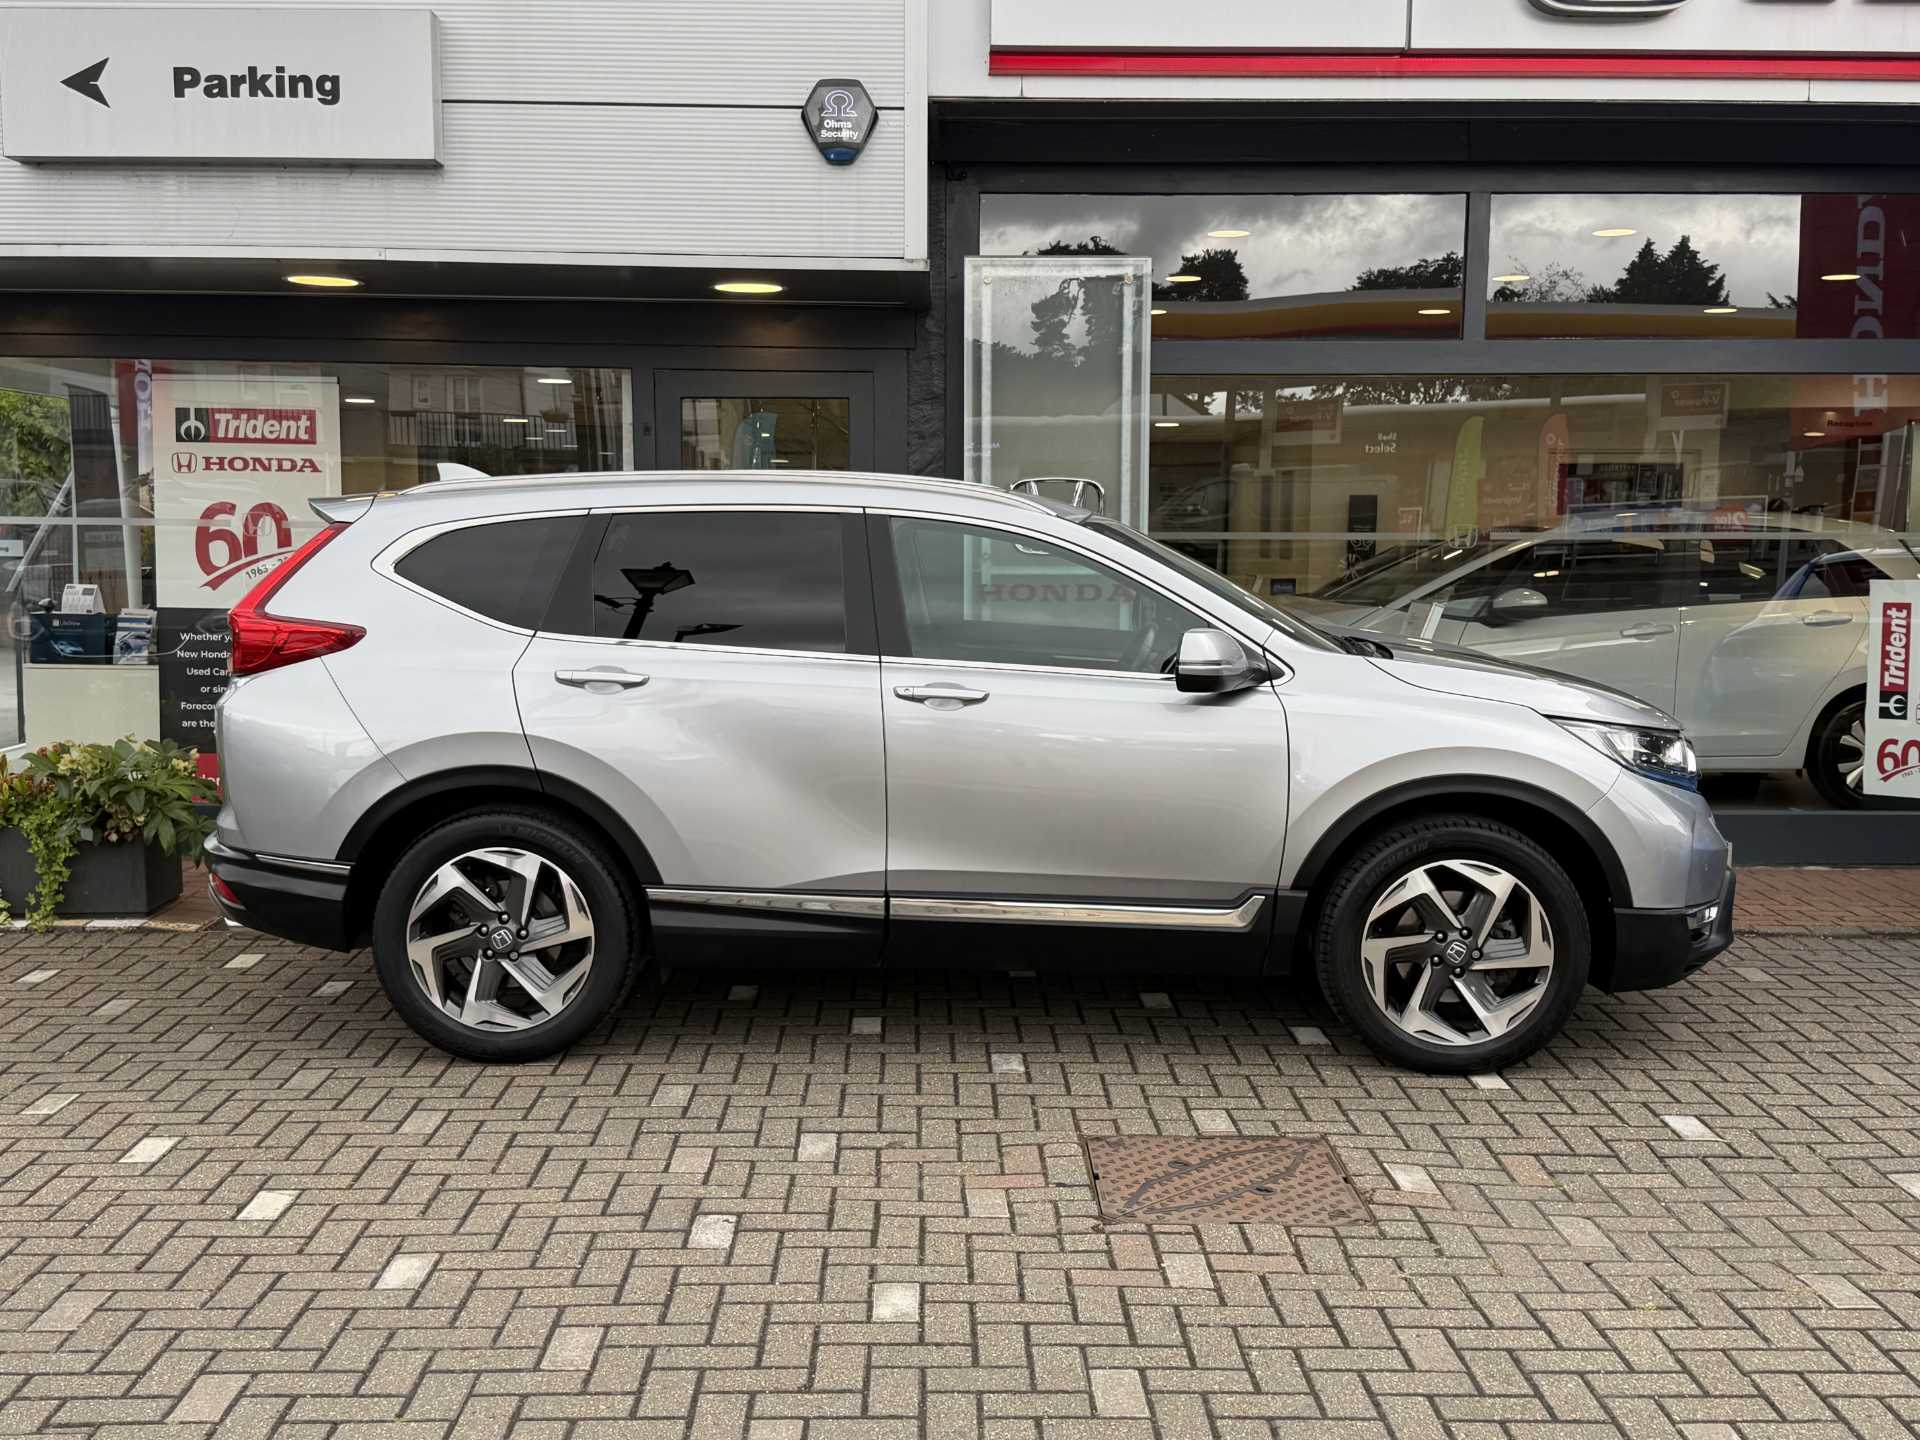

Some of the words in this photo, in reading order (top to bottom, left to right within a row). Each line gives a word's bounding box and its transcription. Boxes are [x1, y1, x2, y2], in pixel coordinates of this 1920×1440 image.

[173, 65, 341, 105] Parking
[824, 119, 853, 129] Ohms
[820, 129, 859, 140] Security
[214, 412, 311, 441] Trident
[202, 456, 322, 473] HONDA
[195, 501, 292, 577] 60
[245, 563, 269, 580] 1963
[976, 583, 1137, 603] HONDA
[180, 632, 223, 641] Whether
[176, 650, 198, 659] New
[1884, 607, 1908, 687] Trident
[186, 667, 211, 676] Used
[181, 720, 197, 728] are
